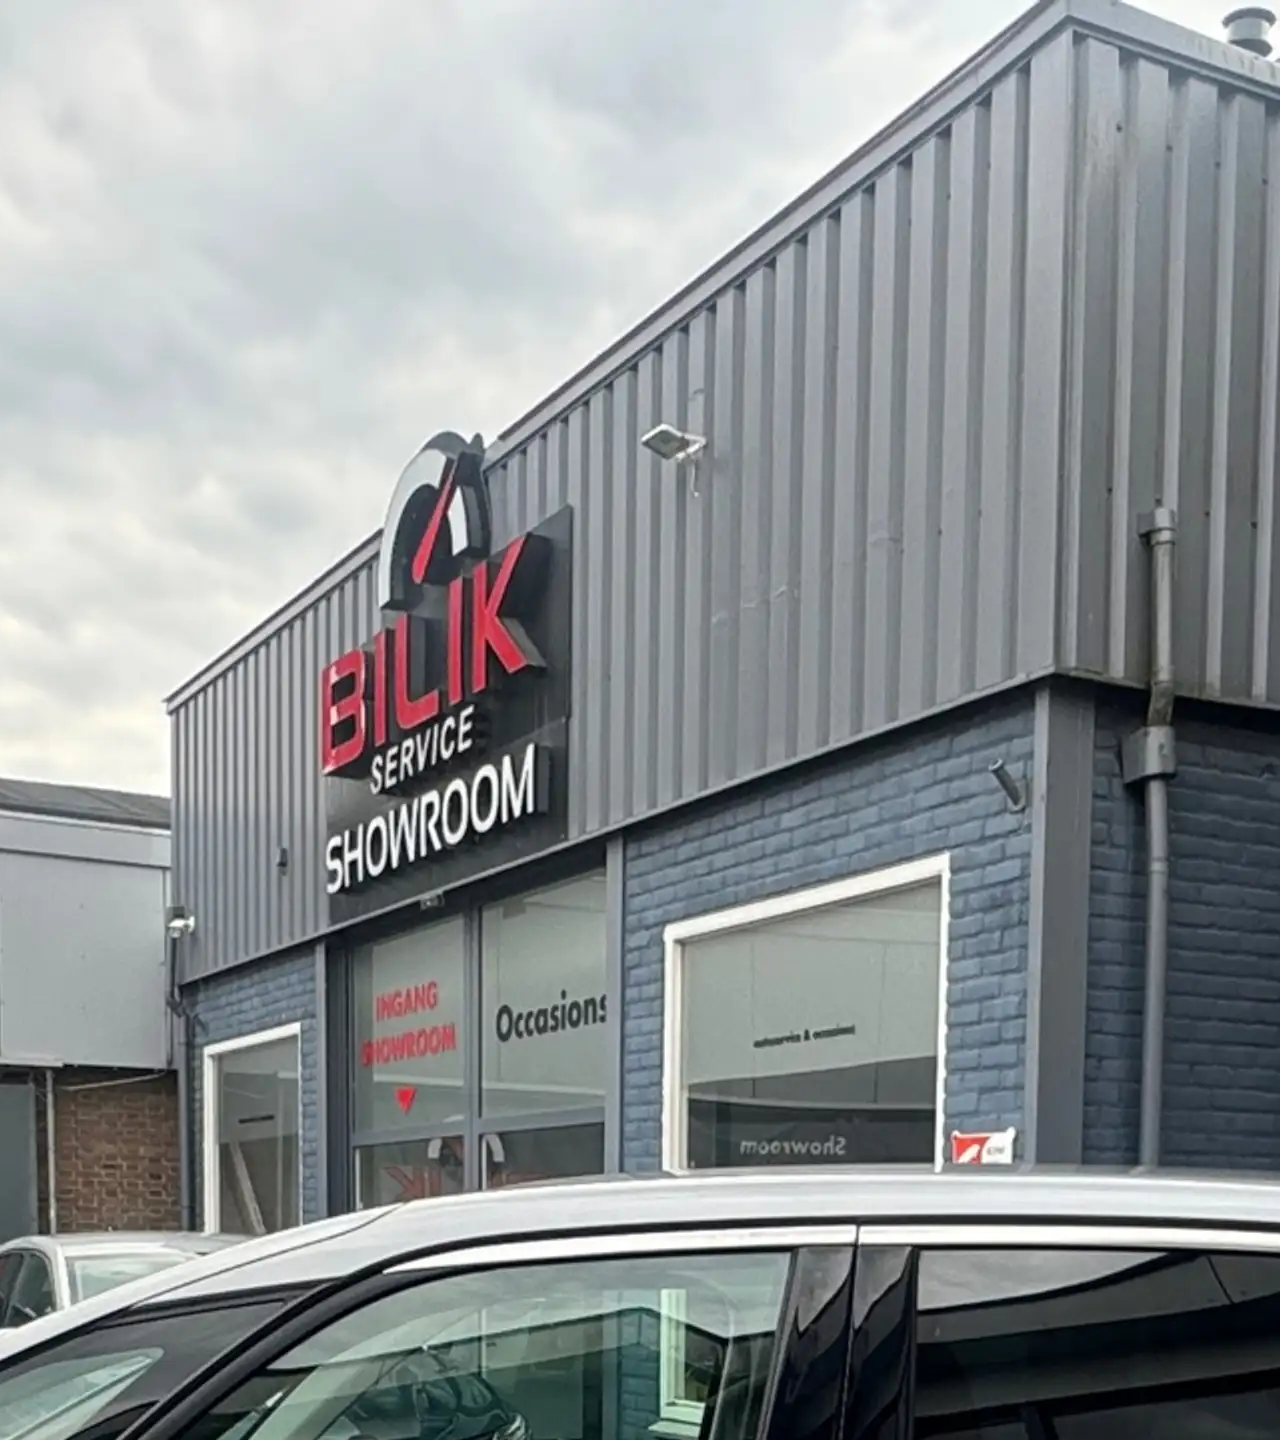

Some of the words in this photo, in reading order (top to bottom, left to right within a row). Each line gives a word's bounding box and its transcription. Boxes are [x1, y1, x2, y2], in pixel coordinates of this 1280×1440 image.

[322, 532, 528, 775] BILIK
[369, 705, 475, 795] SERVICE
[325, 743, 536, 894] SHOWROOM
[376, 979, 438, 1022] INGANG
[496, 989, 608, 1043] Occasions
